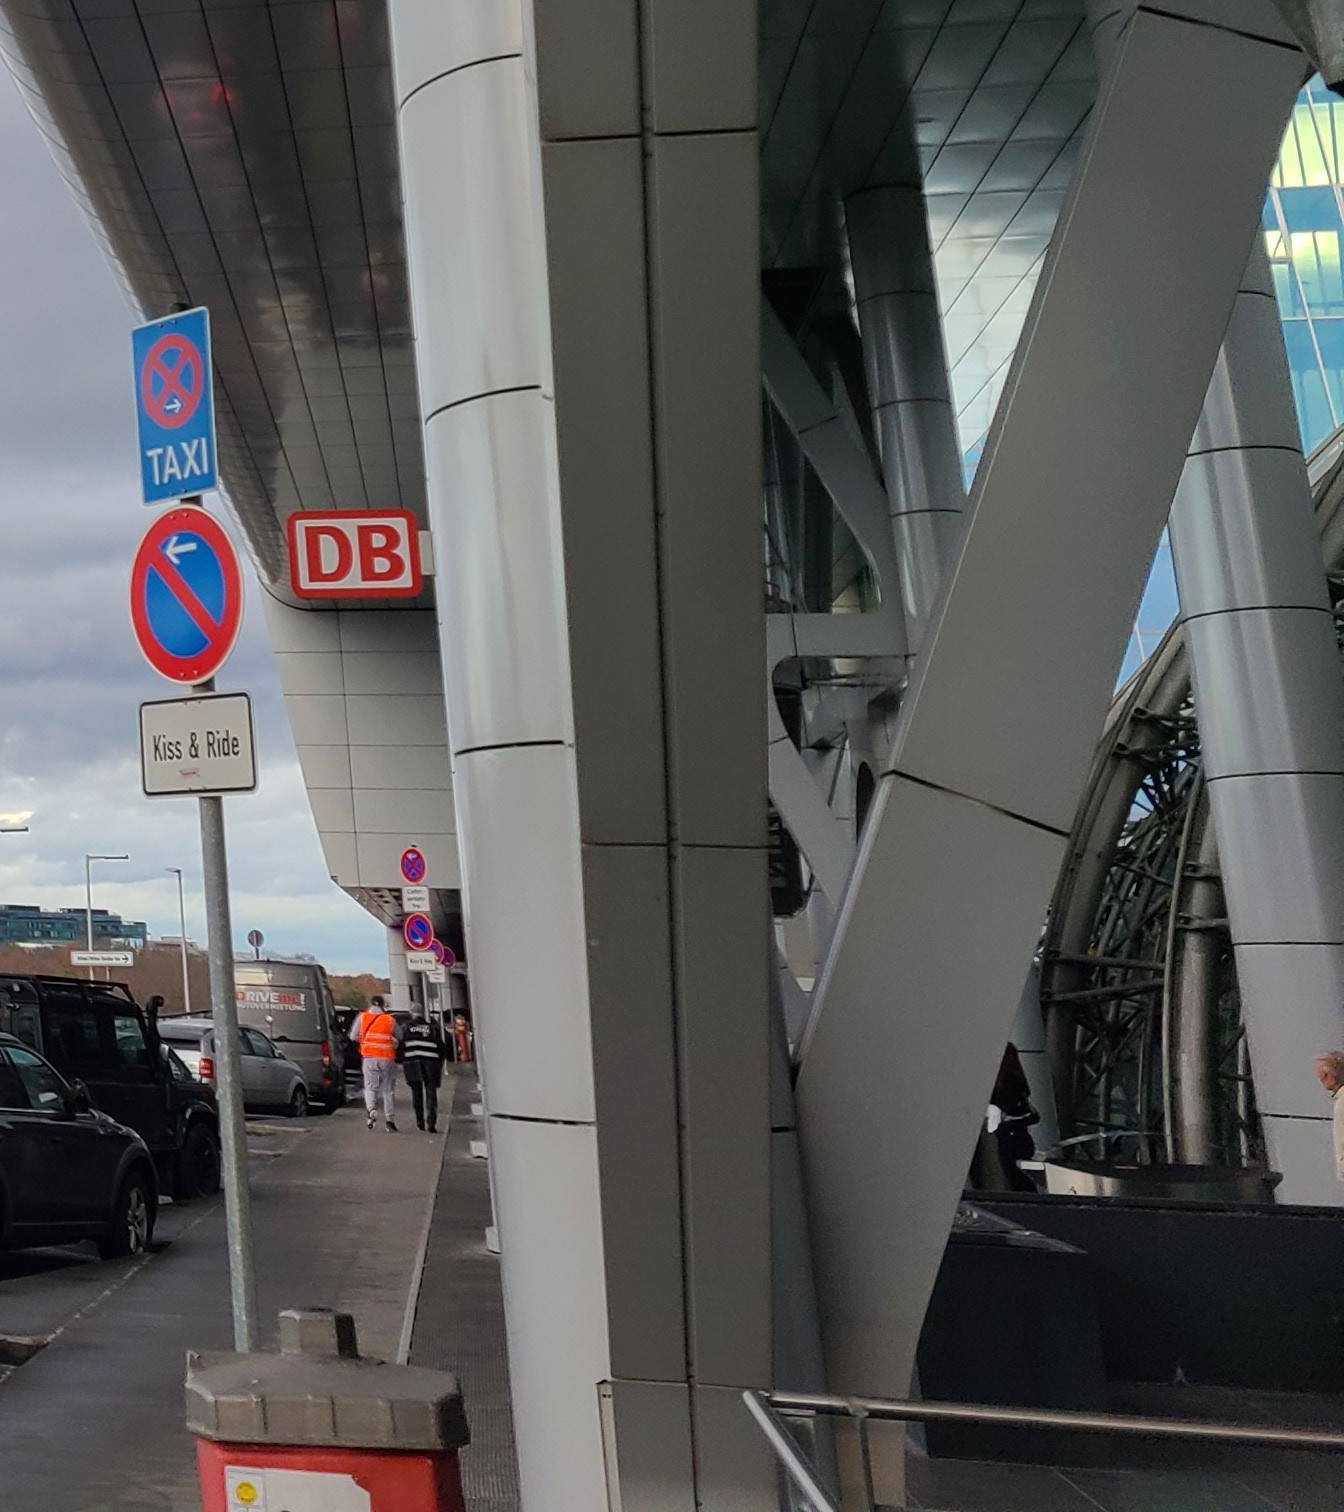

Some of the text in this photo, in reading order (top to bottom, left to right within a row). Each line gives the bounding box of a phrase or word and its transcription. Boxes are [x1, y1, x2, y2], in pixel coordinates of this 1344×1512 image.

[146, 437, 209, 485] TAXI
[304, 525, 406, 582] DB
[153, 729, 241, 762] Kiss & Ride
